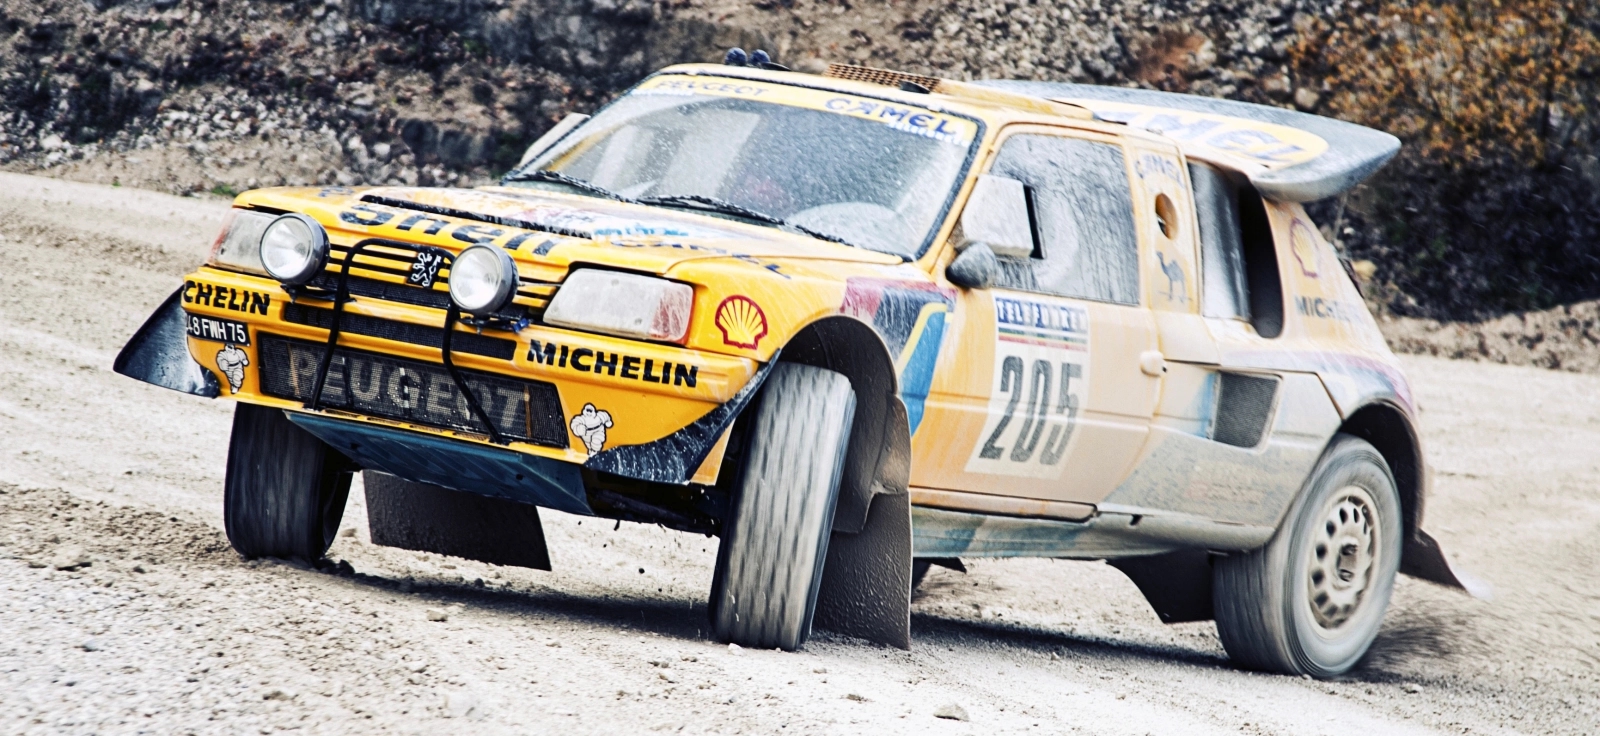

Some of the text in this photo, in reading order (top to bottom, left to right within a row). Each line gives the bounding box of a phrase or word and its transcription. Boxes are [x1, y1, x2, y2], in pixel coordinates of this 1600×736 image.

[825, 97, 956, 135] CAMEL
[201, 318, 227, 340] FWH
[227, 322, 246, 343] 75
[526, 339, 699, 388] MICHELIN
[289, 348, 528, 430] PEUGEOT
[979, 355, 1084, 466] 205
